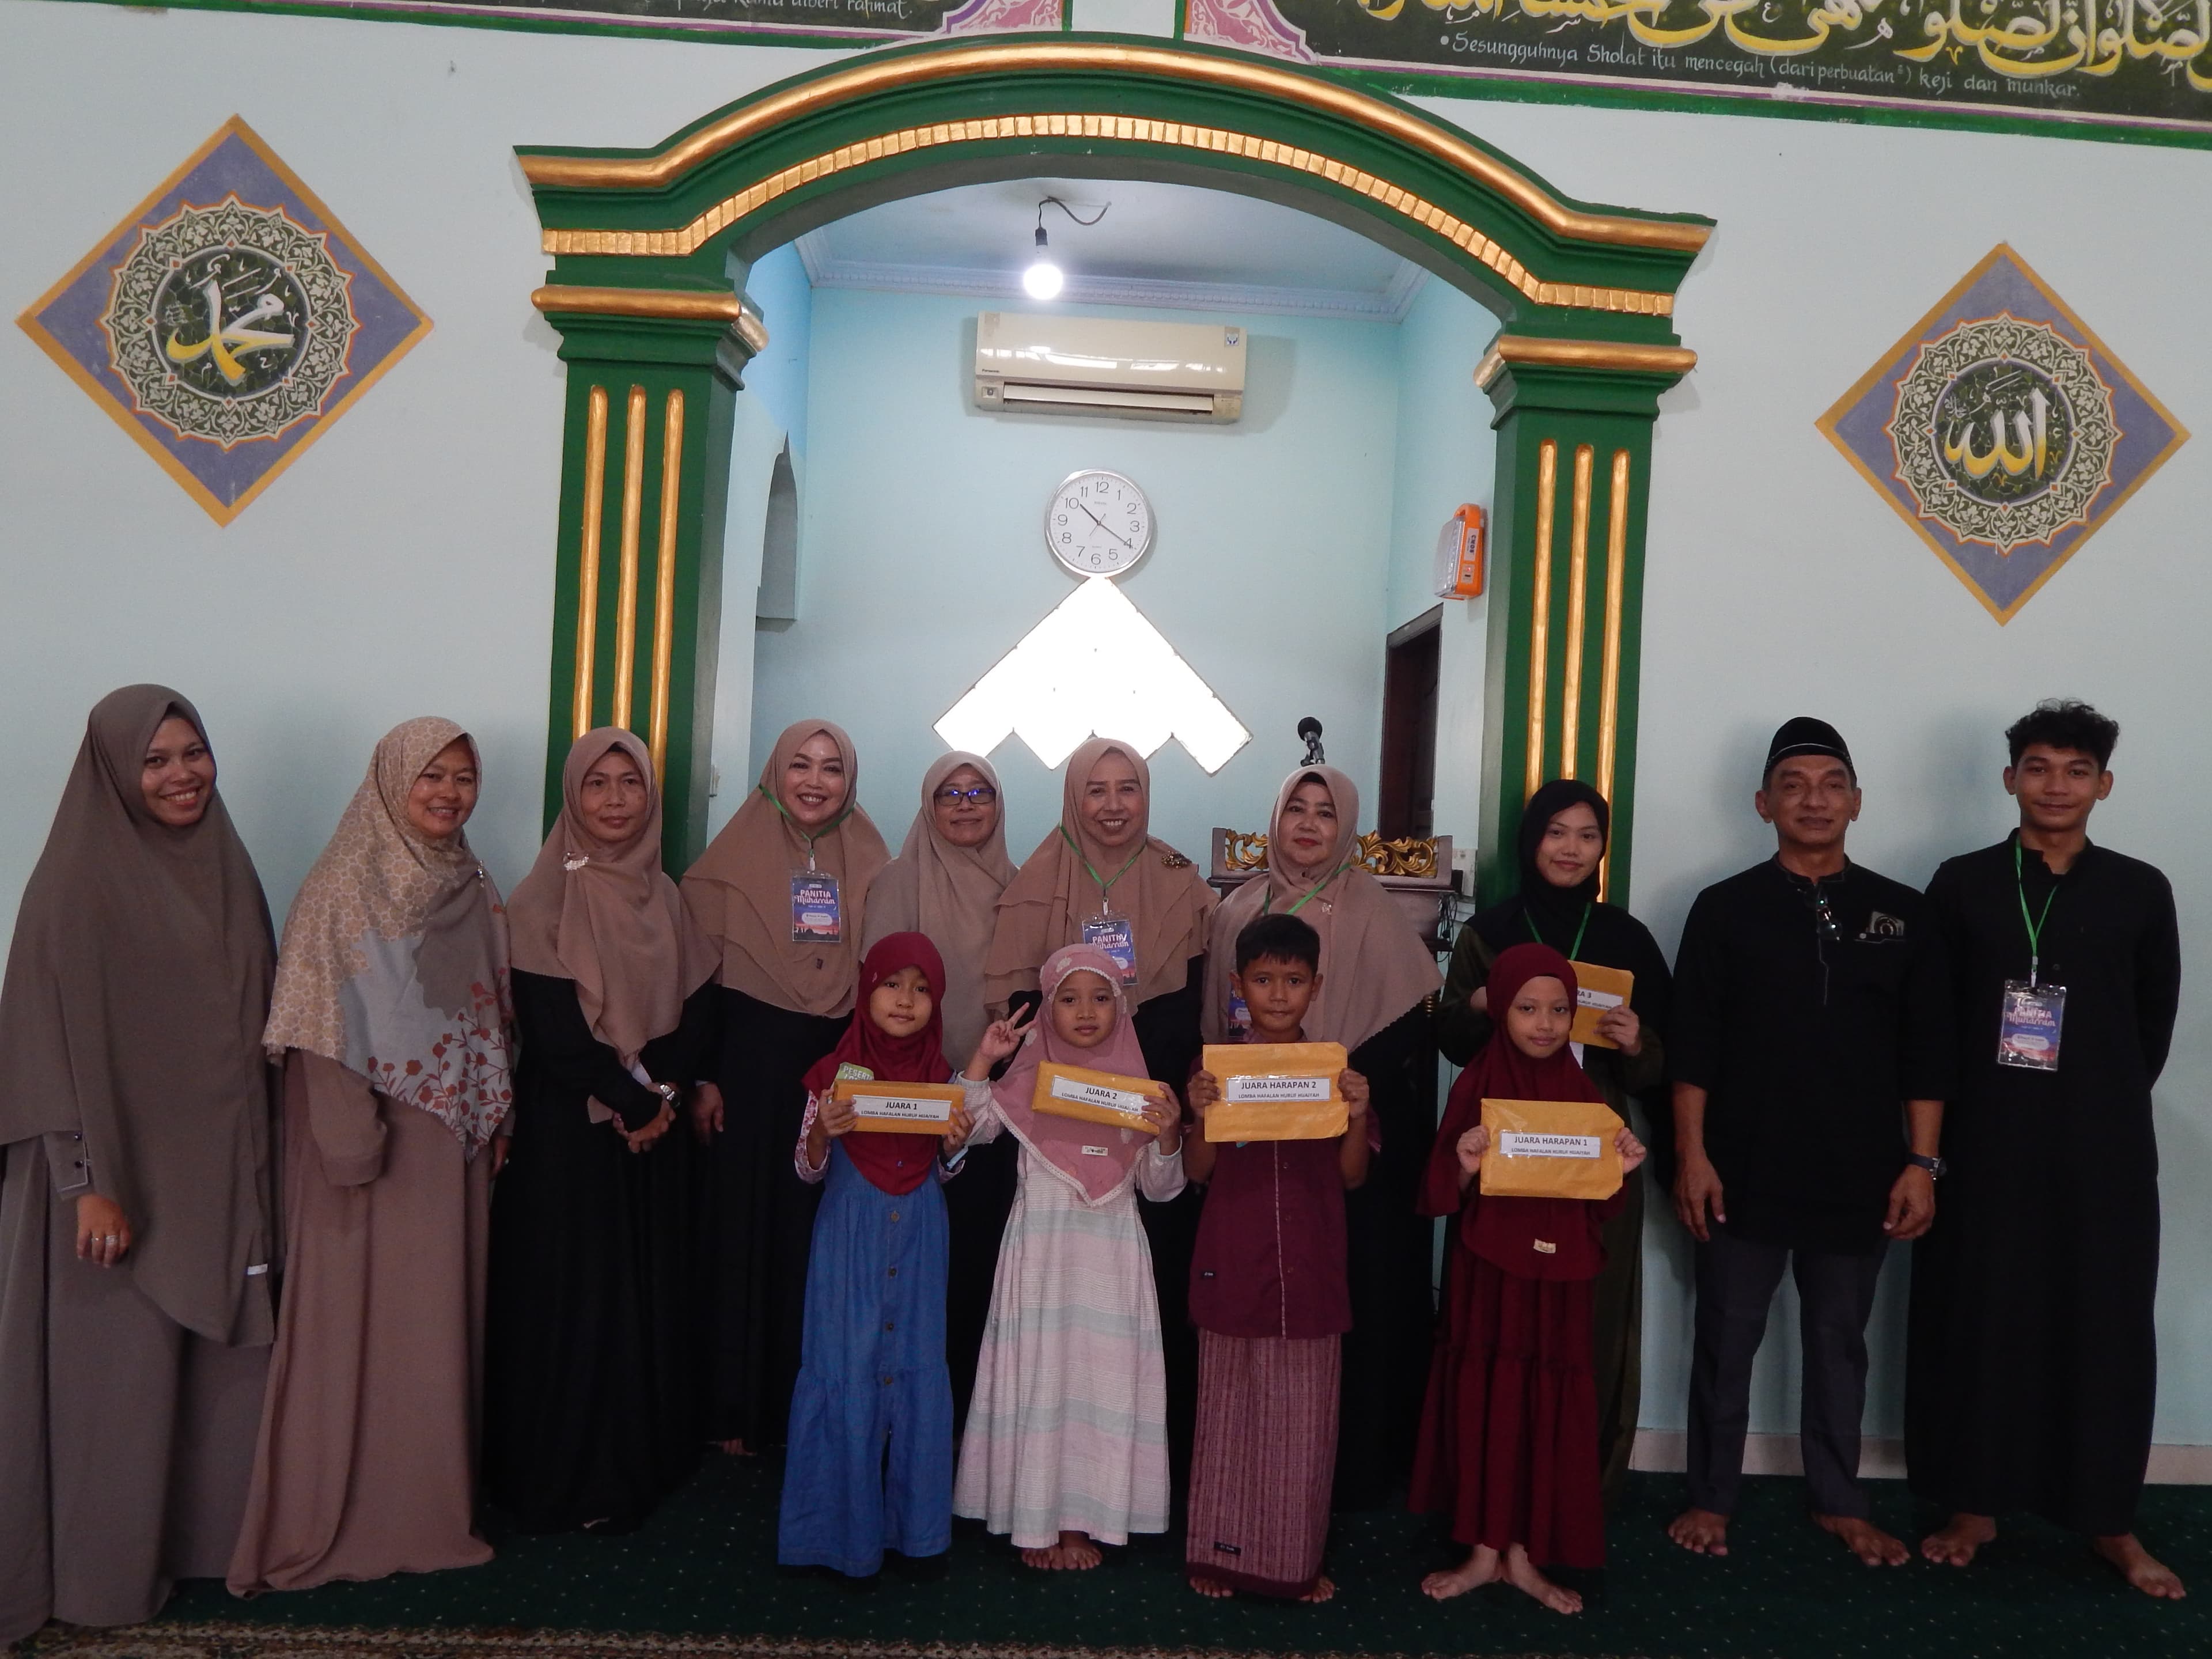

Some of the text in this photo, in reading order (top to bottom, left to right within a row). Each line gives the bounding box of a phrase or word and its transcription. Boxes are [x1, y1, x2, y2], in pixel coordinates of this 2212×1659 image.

[1452, 31, 1578, 68] Sesungguhnya
[1587, 31, 1646, 65] Sholat
[1652, 46, 1676, 70] itu
[1685, 54, 1765, 78] mencegah
[1920, 67, 1952, 96] keji
[1964, 75, 1998, 93] dan
[2007, 78, 2080, 99] munkar.
[1081, 486, 1088, 498] 11
[1096, 481, 1109, 494] 12
[1117, 490, 1121, 501] 1
[1065, 497, 1079, 509] 10
[1127, 503, 1137, 514] 2
[1058, 514, 1067, 526] 9
[1130, 520, 1140, 532] 3
[1062, 532, 1072, 544] 8
[1123, 537, 1132, 549] 4
[1076, 546, 1085, 557] 7
[1108, 548, 1118, 560] 5
[1091, 553, 1101, 565] 6
[800, 889, 831, 898] PANITIA
[794, 895, 835, 905] Muharram
[1085, 1087, 1110, 1098] JUARA
[885, 1101, 911, 1110] JUARA
[1515, 1136, 1540, 1144] JUARA
[1543, 1137, 1581, 1146] HARAPAN
